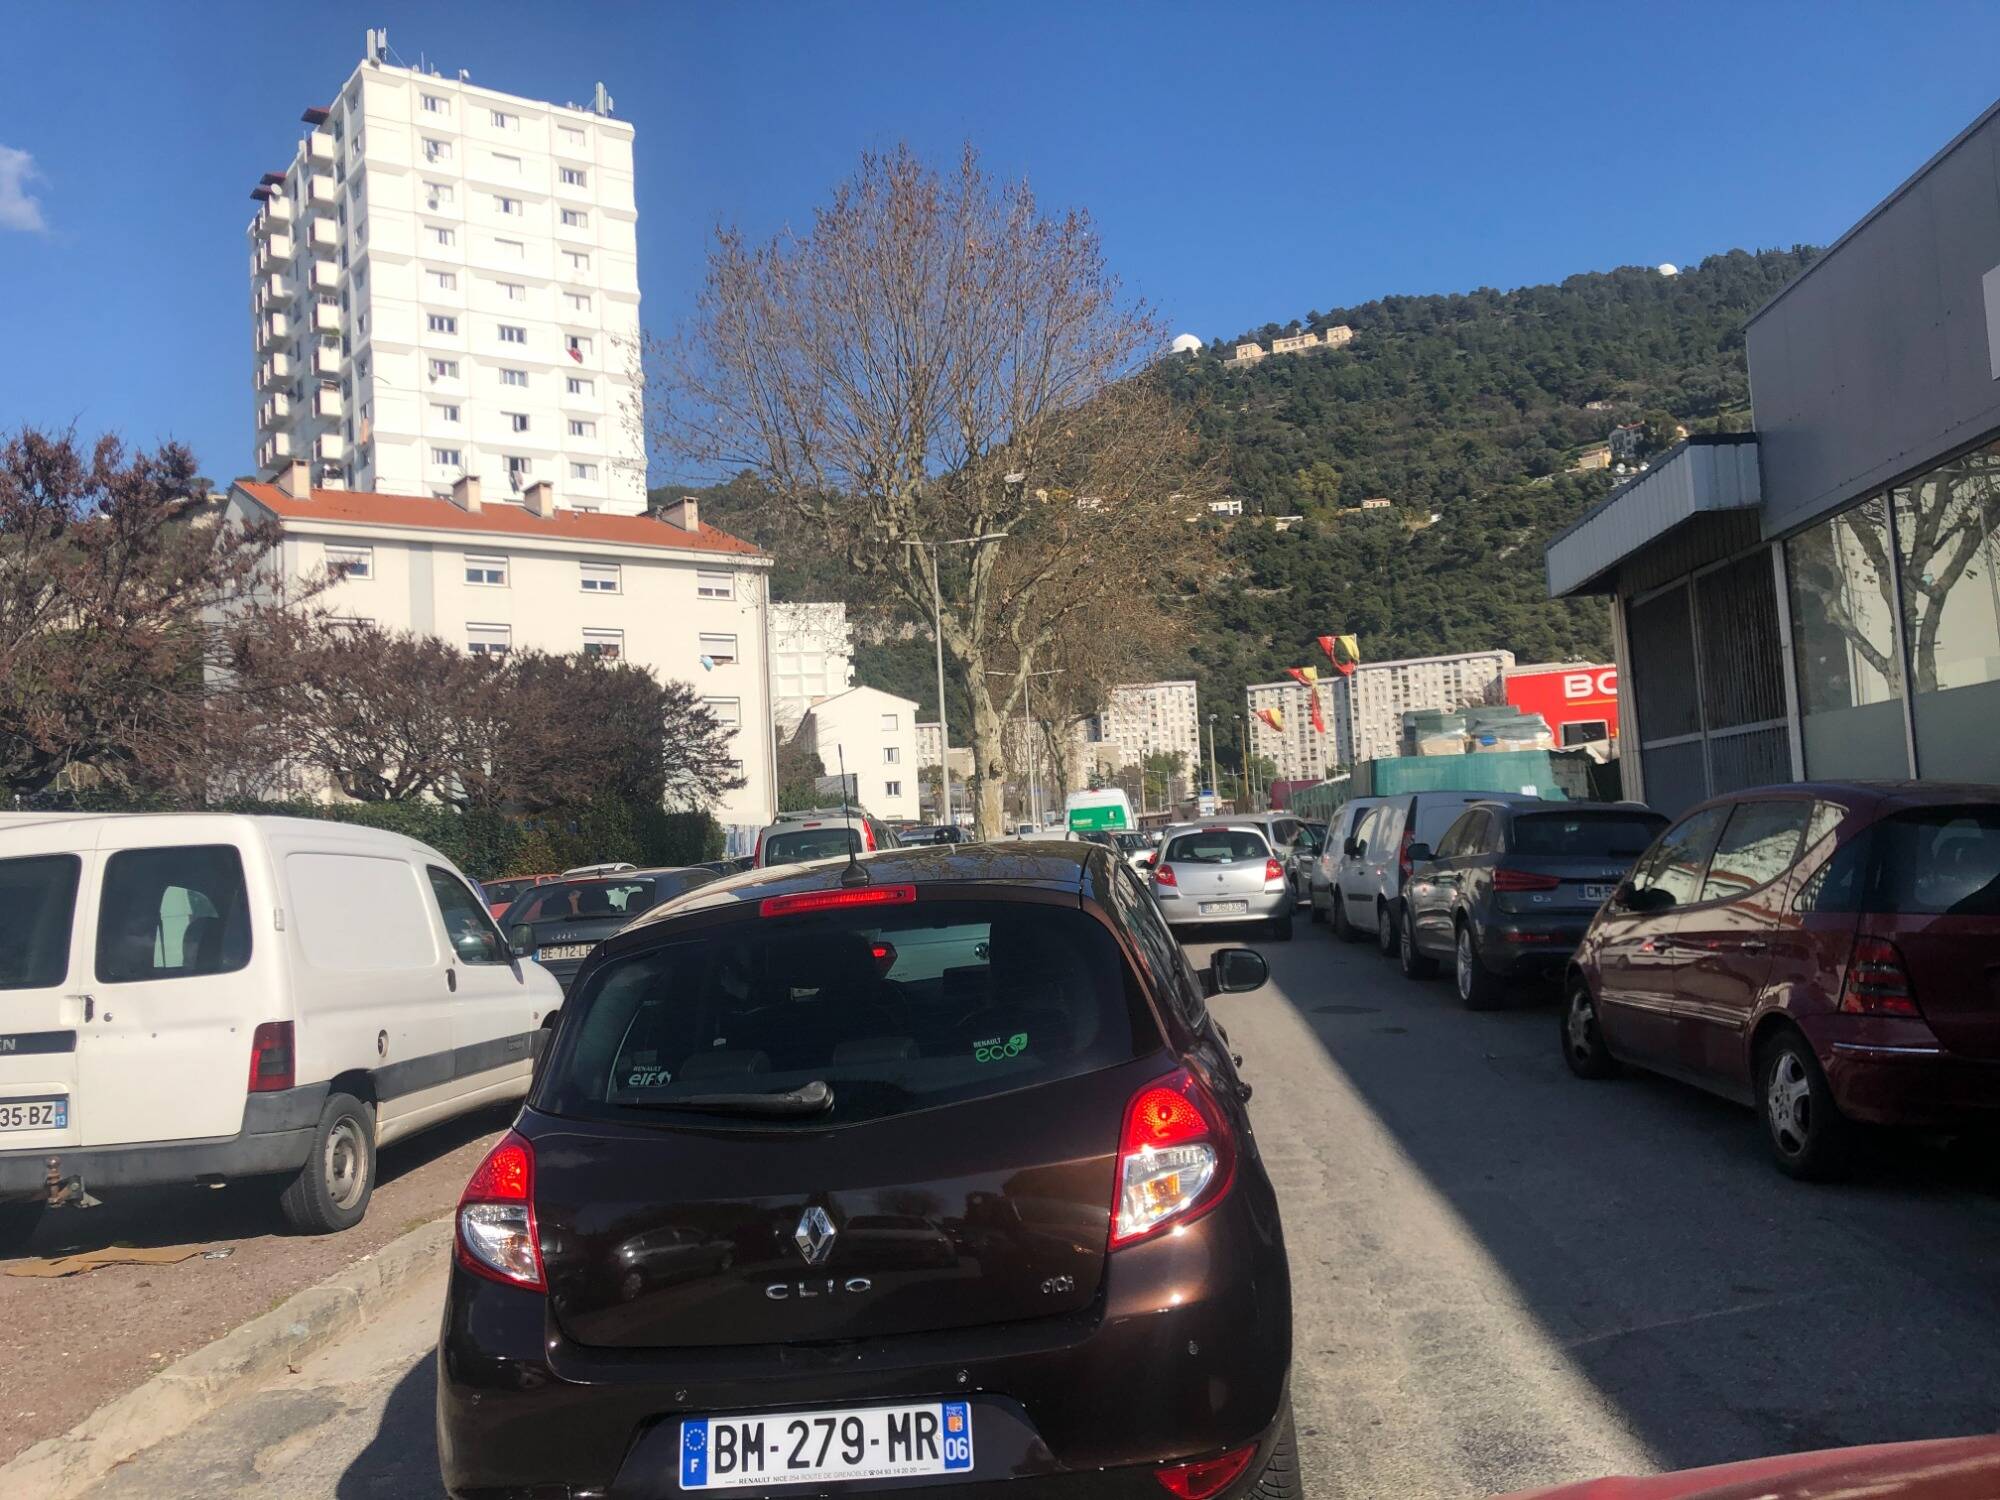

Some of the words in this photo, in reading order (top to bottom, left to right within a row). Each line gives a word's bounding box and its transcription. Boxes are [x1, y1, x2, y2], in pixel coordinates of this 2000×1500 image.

[973, 1037, 1001, 1048] RENAULT
[628, 1072, 657, 1086] elf
[766, 1278, 871, 1299] CLIO
[690, 1458, 699, 1473] F
[715, 1411, 939, 1474] BM-279-MR
[946, 1437, 968, 1461] 06
[738, 1477, 770, 1485] RENAULT
